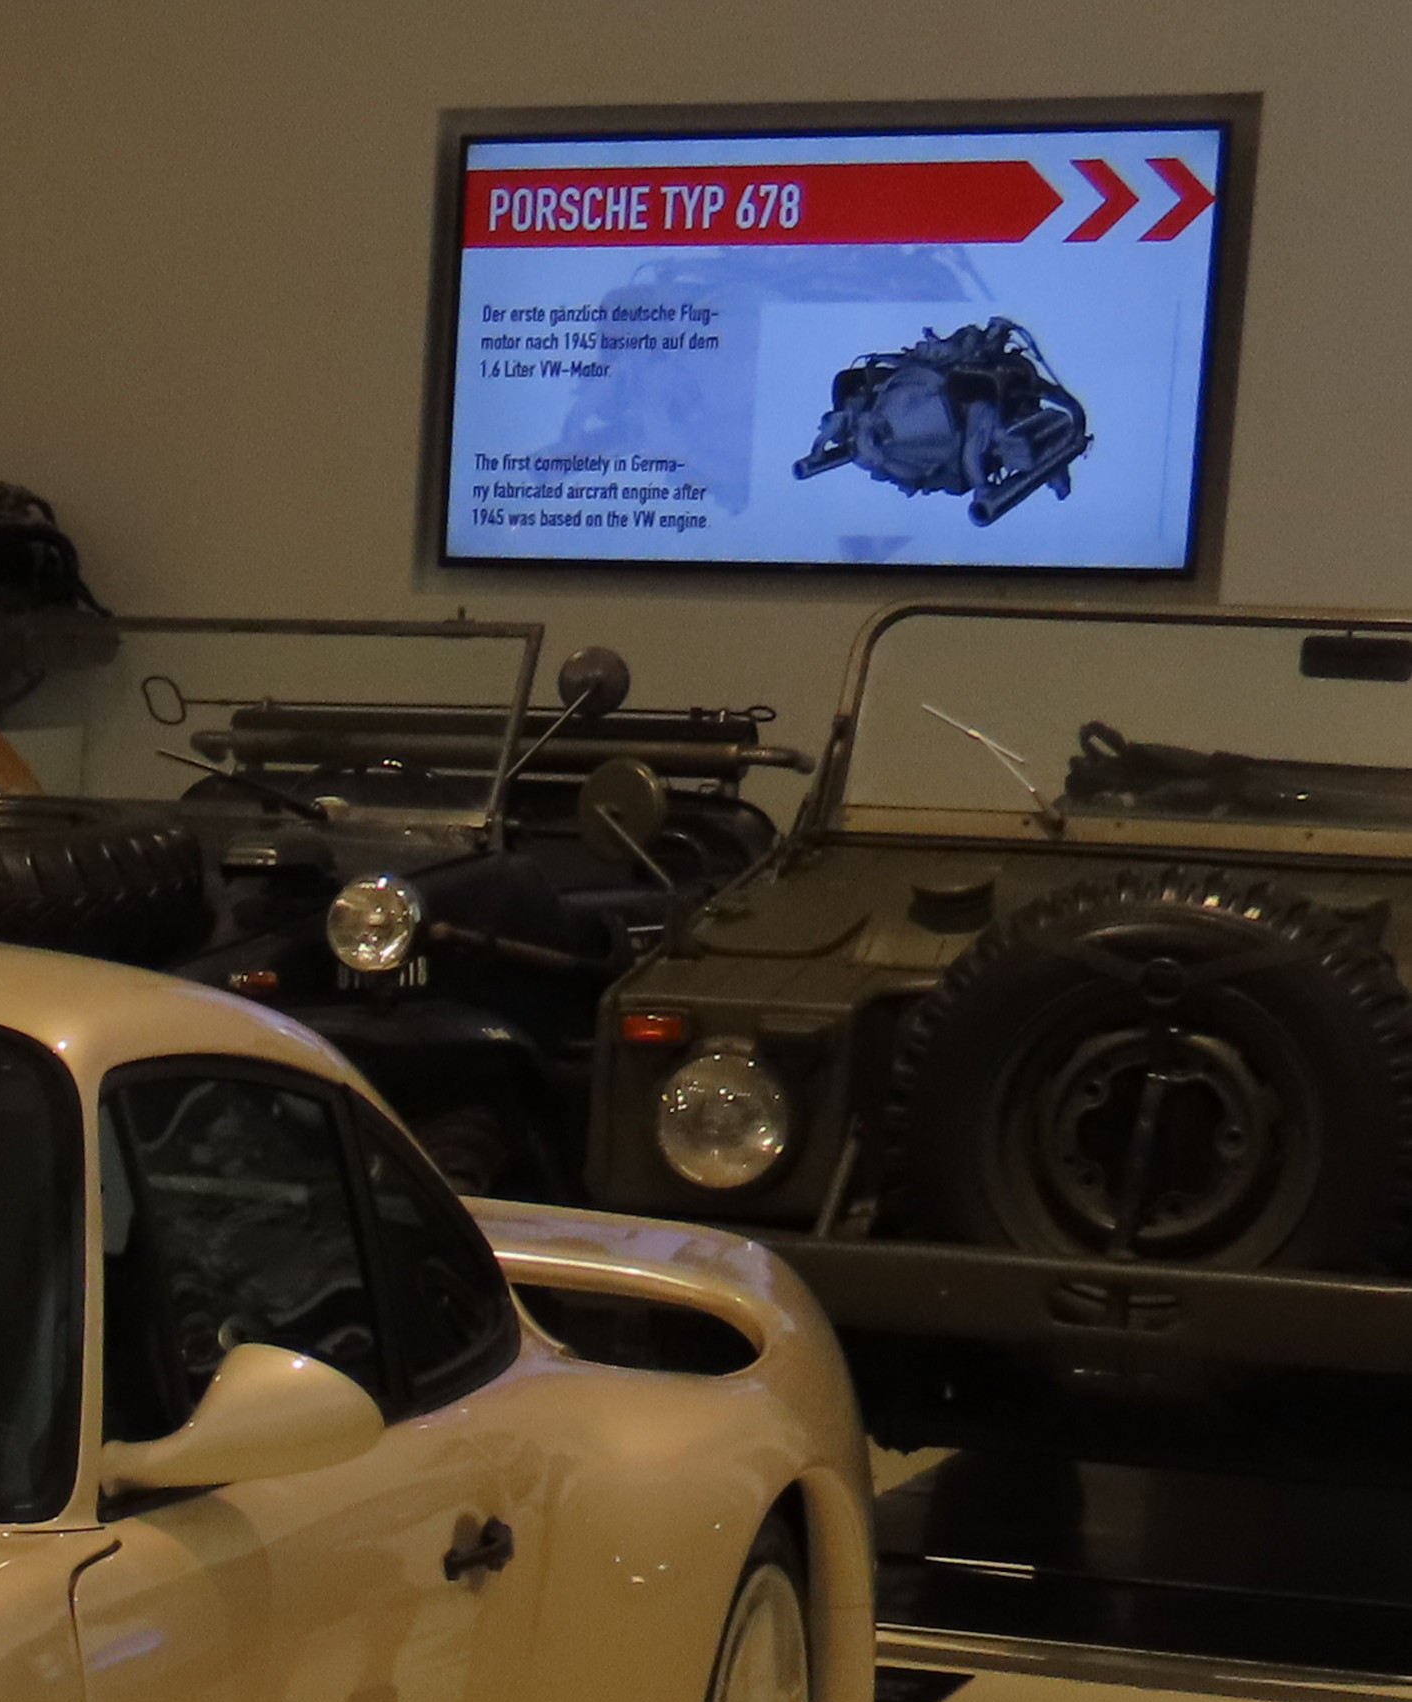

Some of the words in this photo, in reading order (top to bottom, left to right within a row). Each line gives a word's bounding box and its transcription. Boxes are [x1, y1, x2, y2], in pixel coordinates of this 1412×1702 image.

[488, 185, 651, 232] PORSCHE
[660, 184, 725, 231] TYP
[735, 183, 801, 230] 678
[481, 304, 506, 323] Der
[510, 306, 545, 323] erste
[549, 305, 608, 327] gänzlich
[611, 304, 676, 323] deutsche
[680, 304, 719, 327] Flug-
[480, 334, 521, 350] motor
[525, 333, 559, 350] nach
[564, 332, 597, 350] 1945
[600, 332, 657, 350] basierte
[662, 332, 685, 350] auf
[688, 332, 720, 350] dem
[479, 360, 500, 378] 1.6
[504, 360, 535, 378] Liter
[539, 360, 612, 379] VW-Motor.
[475, 453, 499, 472] The
[503, 453, 529, 472] first
[534, 454, 610, 477] completely
[614, 455, 627, 472] in
[630, 455, 686, 473] Germa-
[472, 484, 489, 502] ny
[492, 482, 564, 500] fabricated
[566, 482, 618, 500] aircraft
[621, 483, 670, 506] engine
[672, 483, 706, 501] after
[472, 508, 505, 526] 1945
[508, 511, 536, 527] was
[540, 509, 582, 528] based
[585, 513, 603, 528] on
[606, 510, 628, 528] the
[632, 511, 655, 529] VW
[658, 511, 712, 534] engine.
